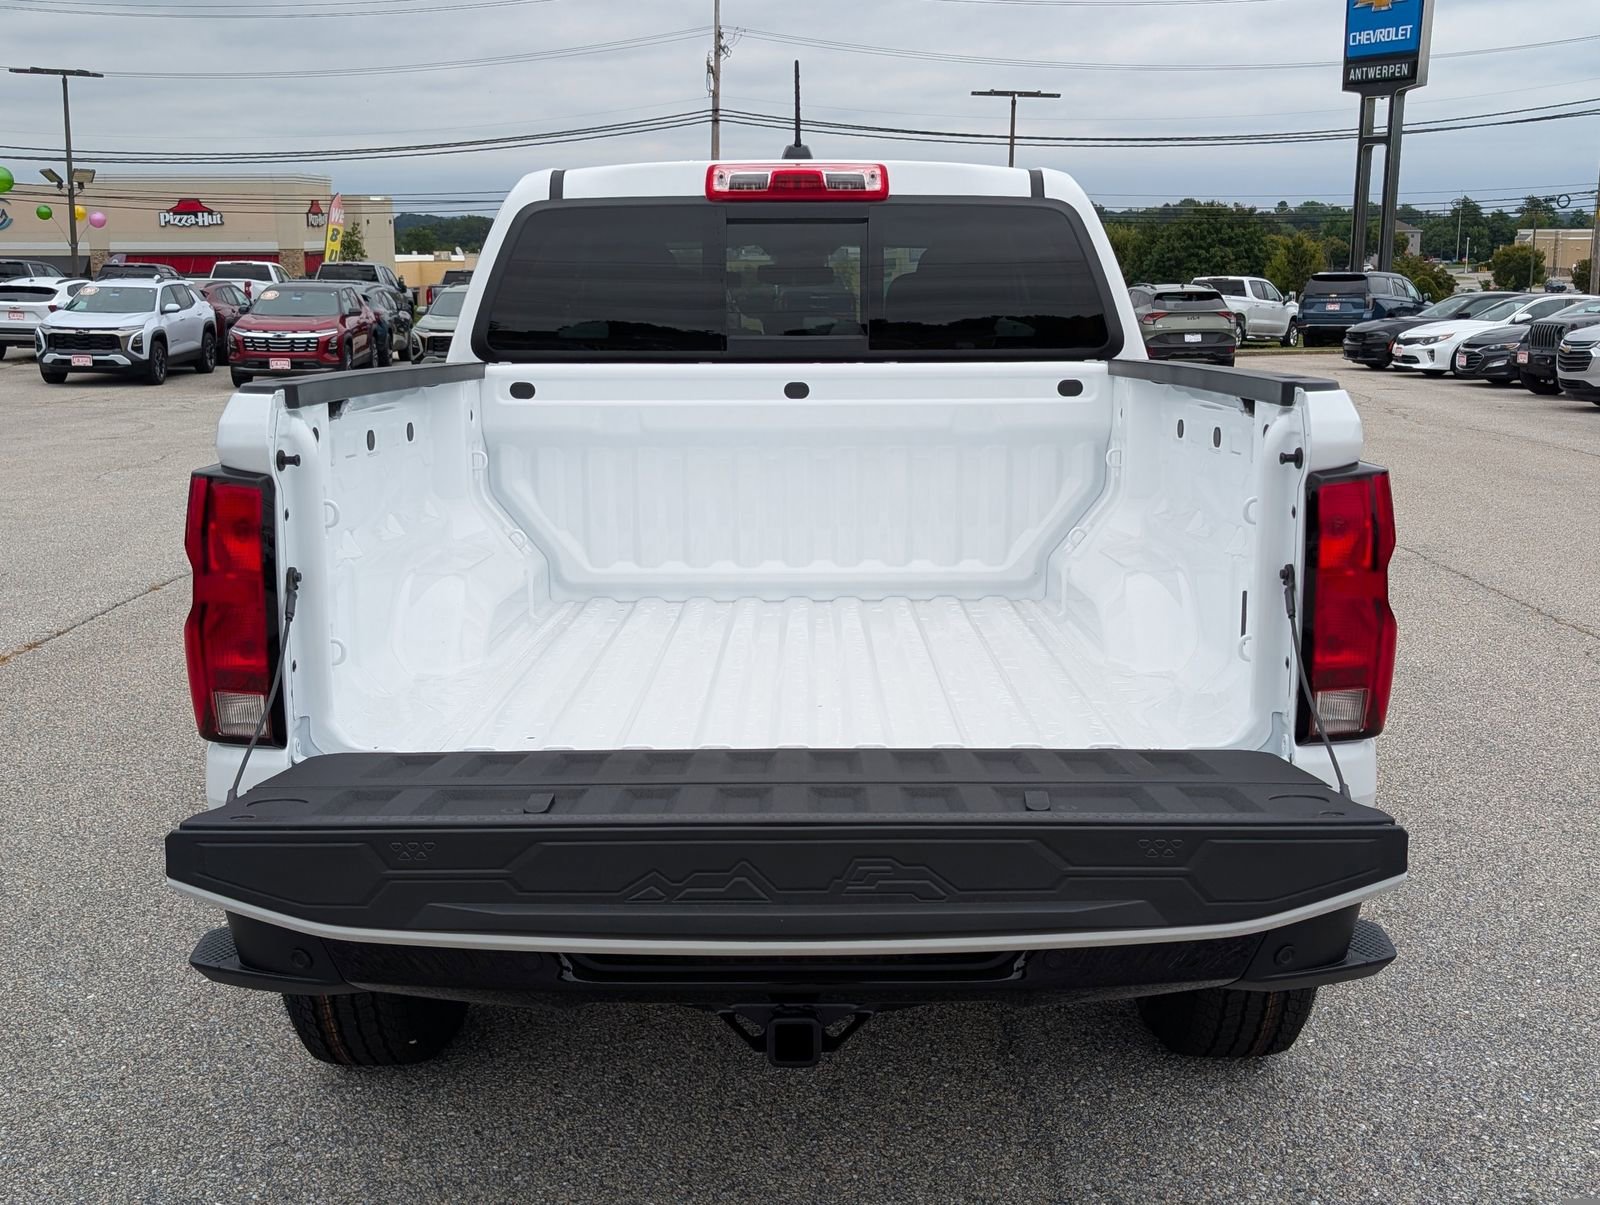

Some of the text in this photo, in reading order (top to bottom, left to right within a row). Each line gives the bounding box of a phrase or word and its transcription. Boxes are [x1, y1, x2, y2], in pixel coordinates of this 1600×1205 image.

[1349, 25, 1413, 46] CHEVROLET
[1349, 63, 1408, 81] ANTWERPEN
[159, 211, 222, 226] Pizza Hut
